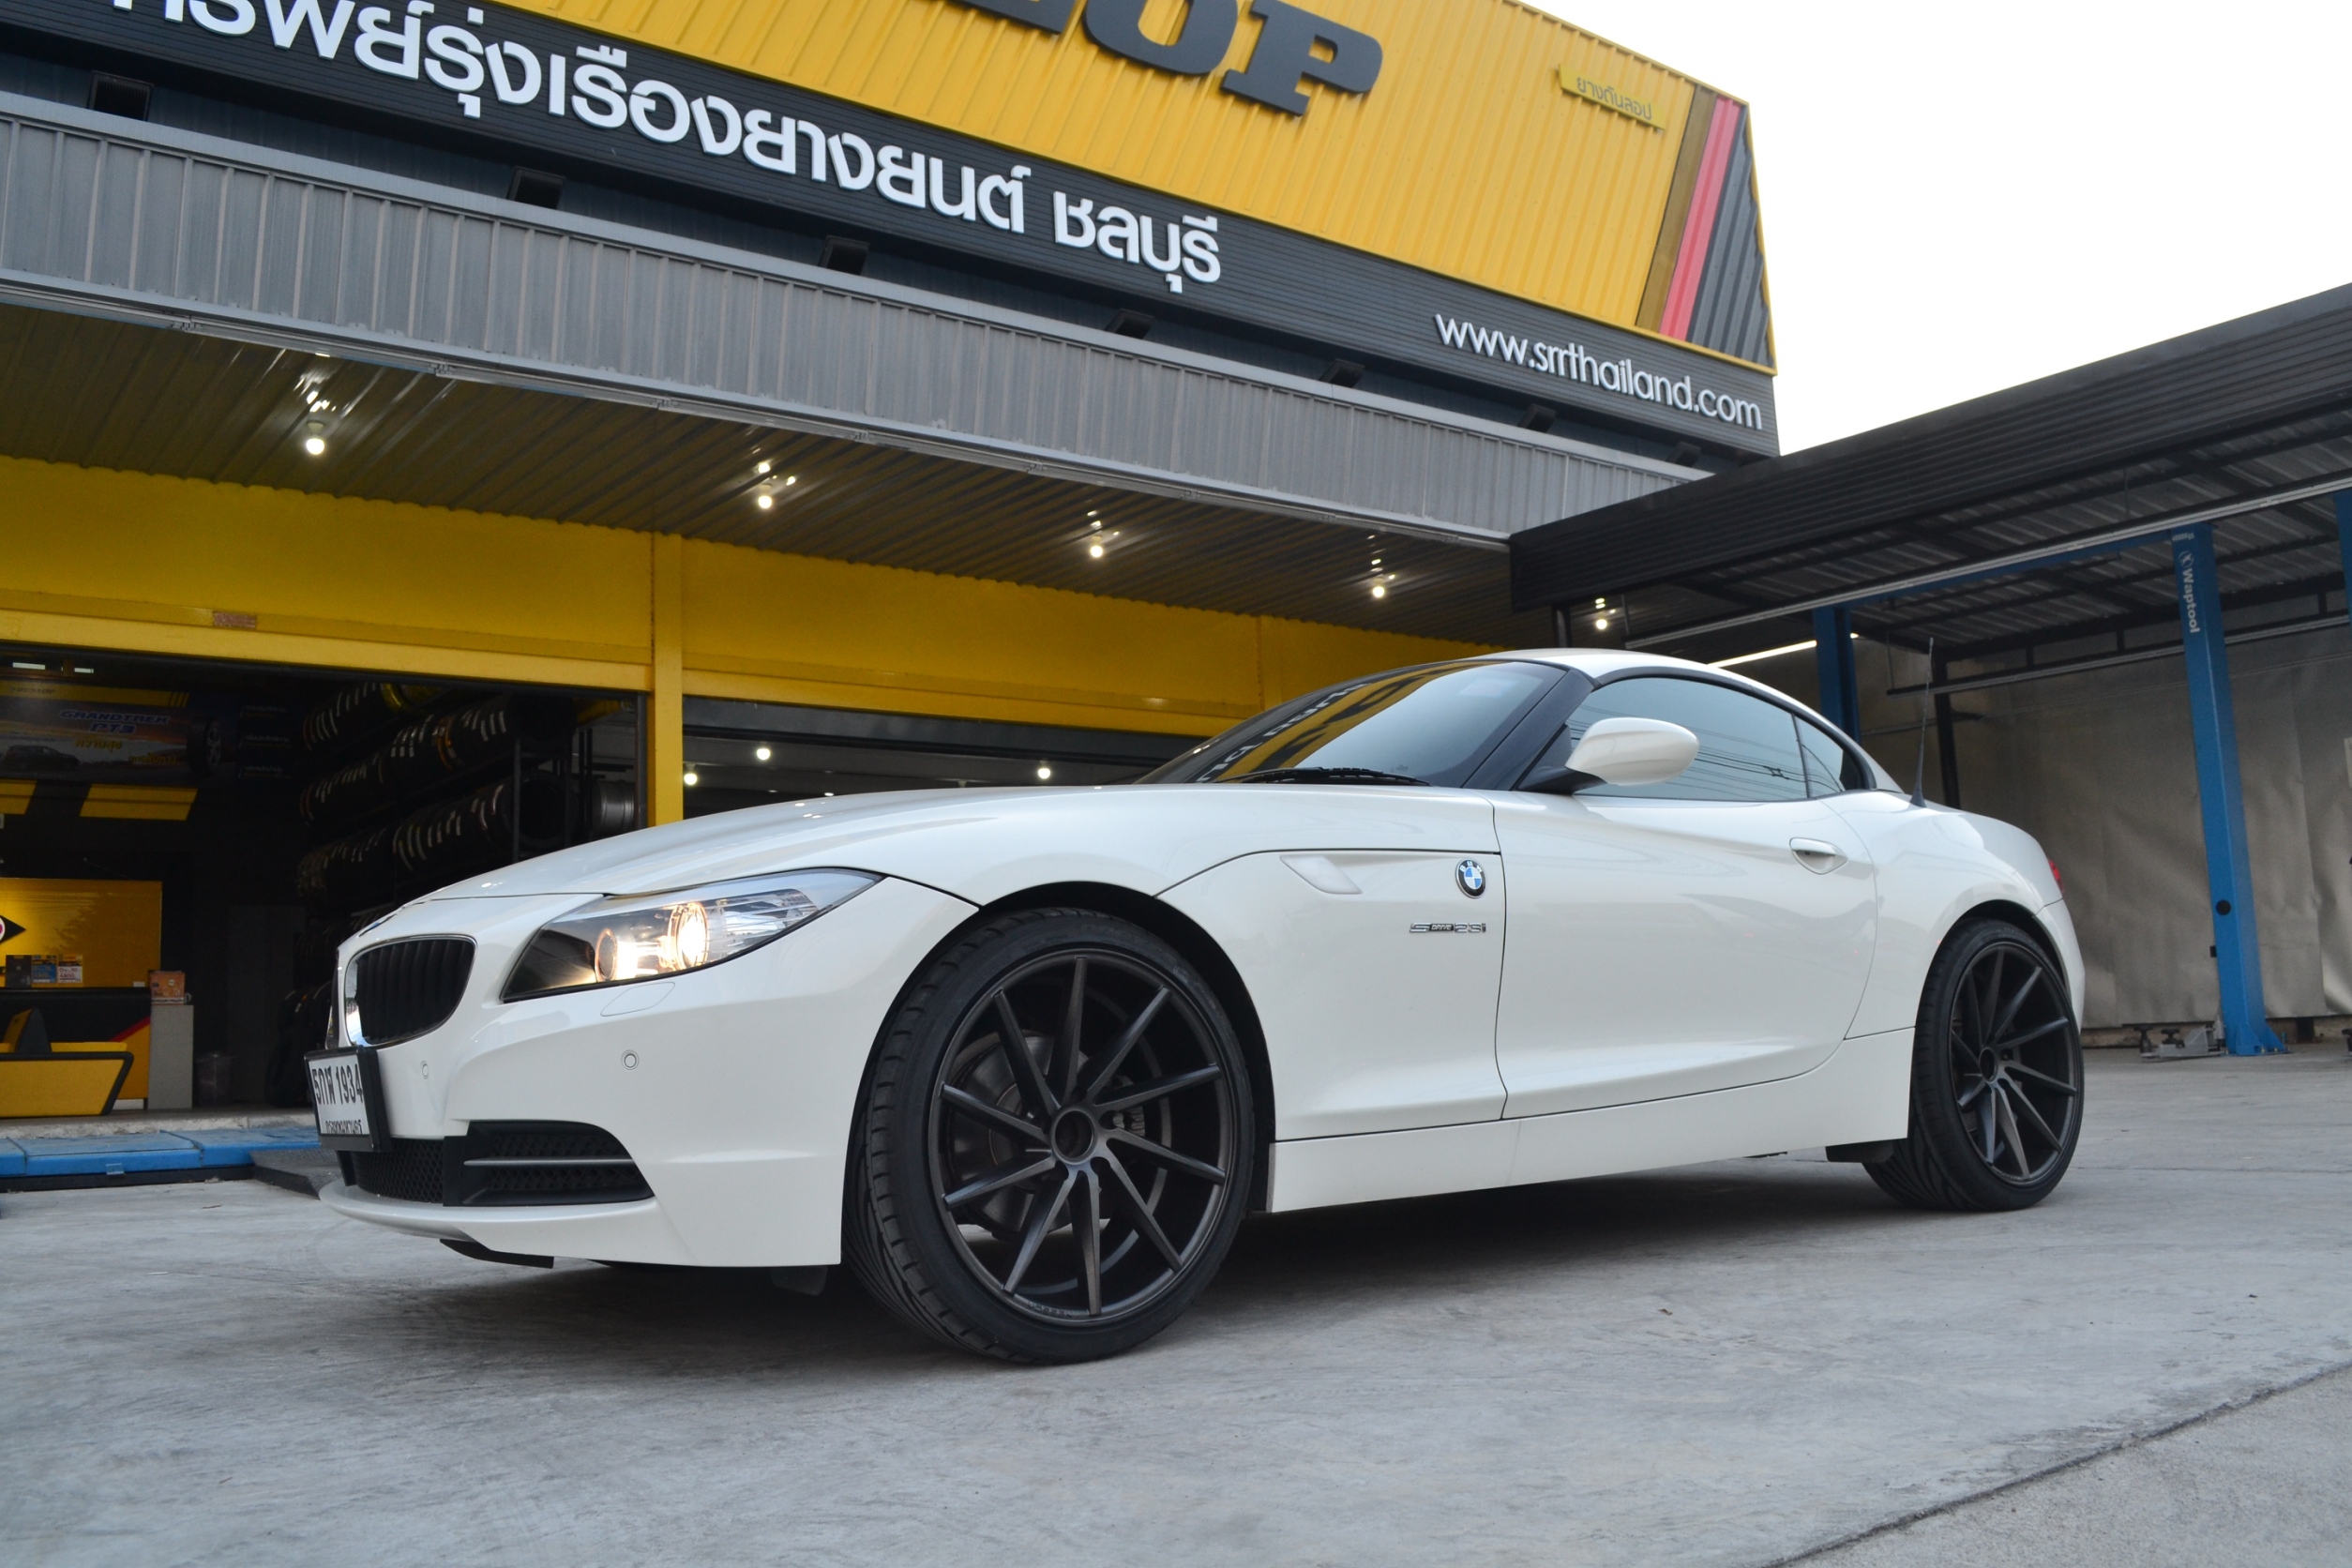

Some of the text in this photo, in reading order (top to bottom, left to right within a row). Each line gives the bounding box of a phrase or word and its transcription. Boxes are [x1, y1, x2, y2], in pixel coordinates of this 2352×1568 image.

[924, 0, 1383, 117] OP
[1053, 190, 1221, 293] ชลบุรี
[1434, 313, 1763, 431] www.srrthailand.com
[2181, 567, 2200, 633] Waptool
[60, 709, 170, 725] GRANDTREK
[89, 721, 136, 734] PT3
[336, 1063, 364, 1105] 1934
